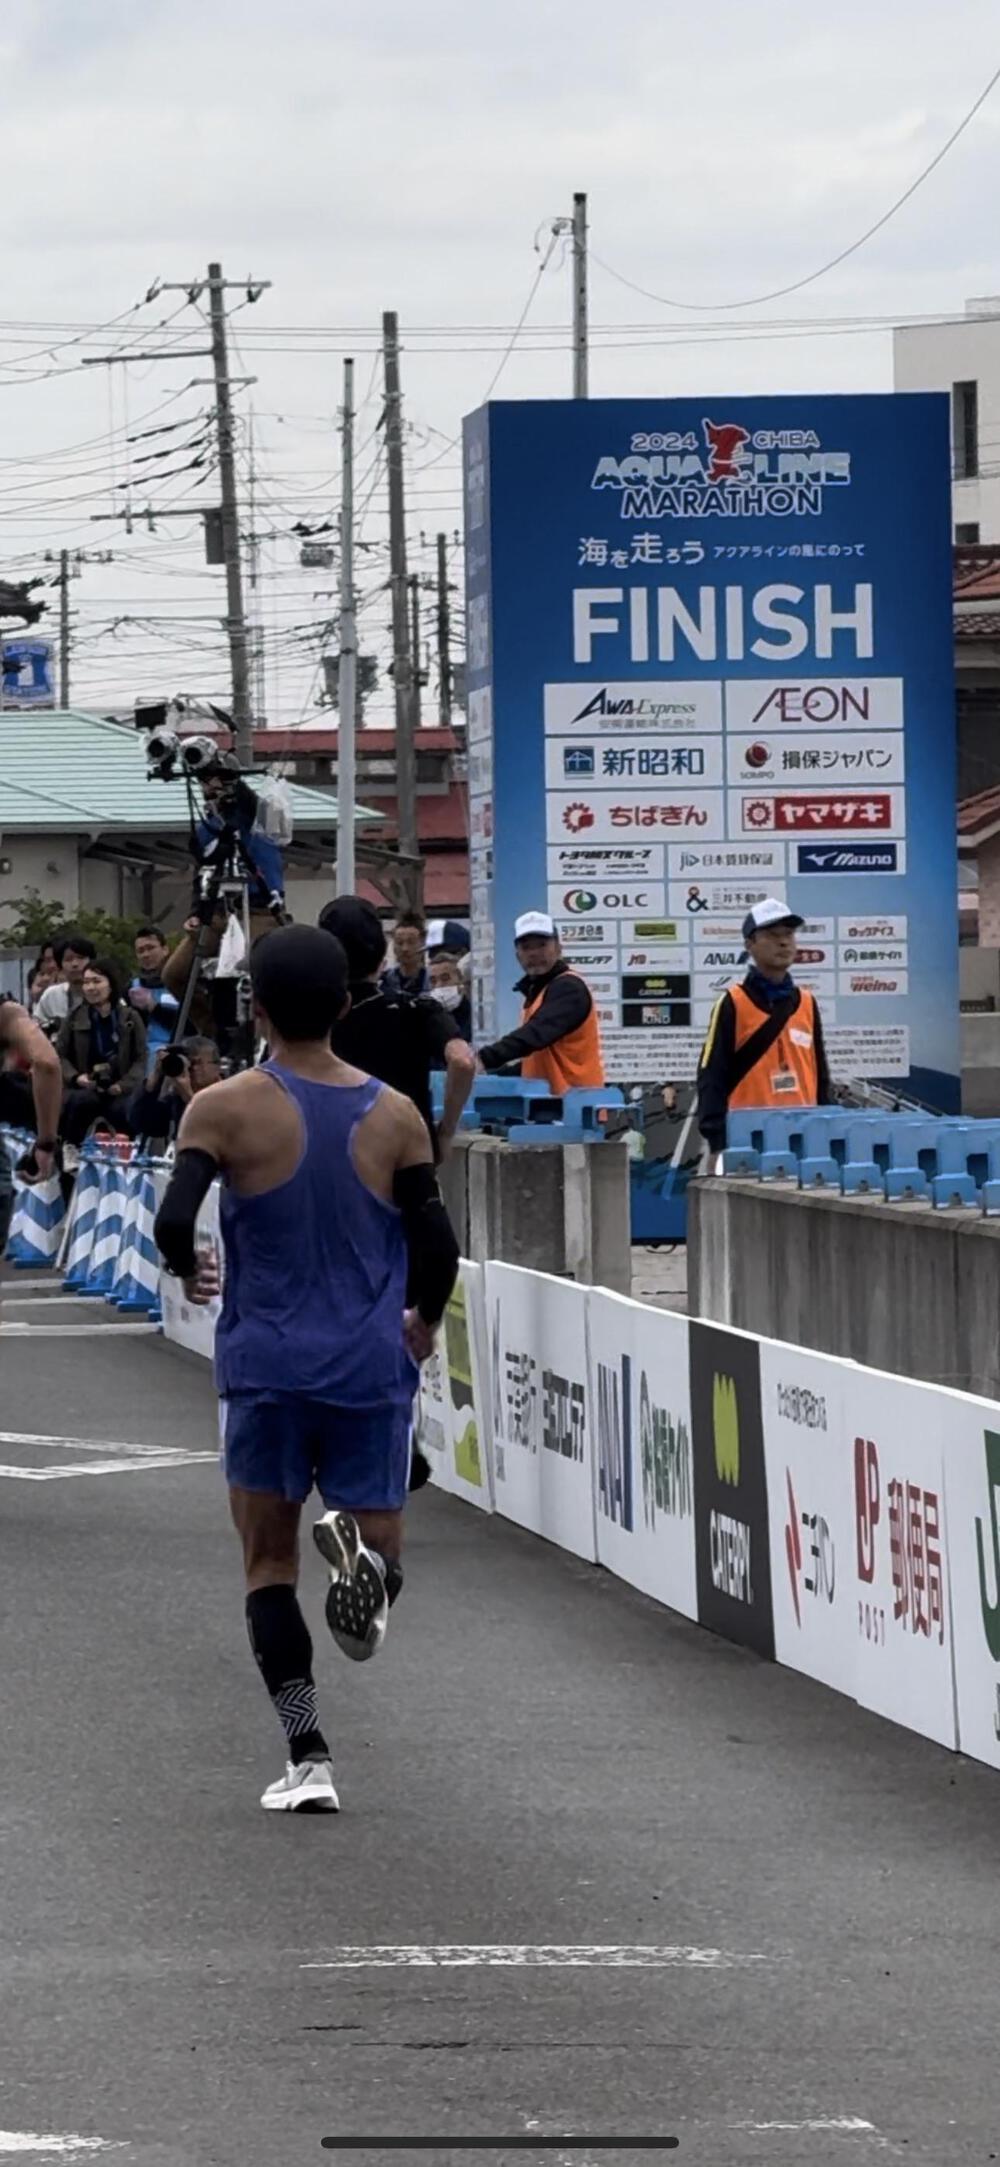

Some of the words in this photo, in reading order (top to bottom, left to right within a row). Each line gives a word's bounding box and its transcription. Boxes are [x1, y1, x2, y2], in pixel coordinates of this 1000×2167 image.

[631, 432, 697, 451] 2024
[752, 430, 819, 448] CHIBA
[591, 453, 710, 488] AQUA
[757, 452, 851, 485] LINE
[621, 487, 822, 518] MARATHON
[578, 533, 705, 568] 海を走ろう
[572, 583, 874, 663] FINISH
[602, 748, 704, 776] 新昭和
[782, 749, 892, 771] 損保ジャパン
[740, 771, 775, 779] SOMPO
[609, 805, 708, 827] ちばぎん
[781, 802, 883, 824] ヤマザキ
[603, 893, 648, 908] OLC
[703, 952, 736, 965] ANA
[887, 1477, 943, 1646] 郵便局
[859, 1601, 885, 1647] POST
